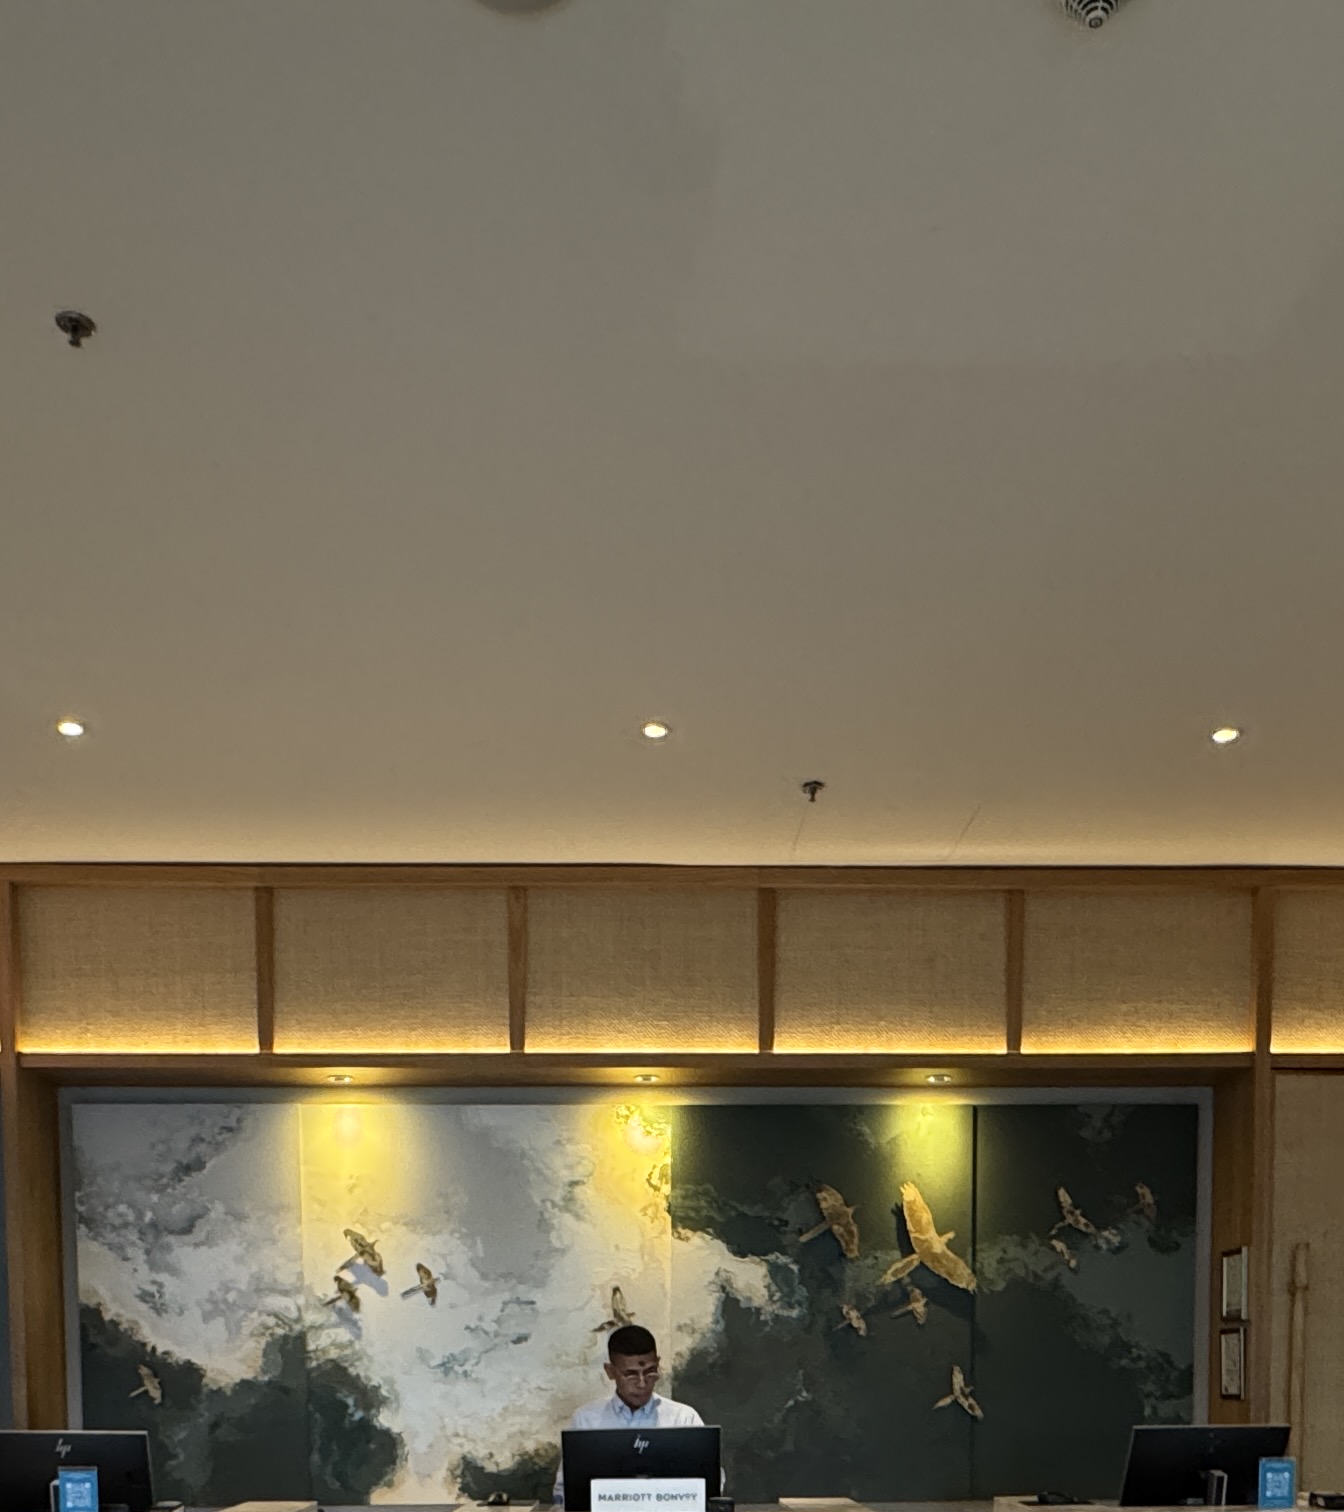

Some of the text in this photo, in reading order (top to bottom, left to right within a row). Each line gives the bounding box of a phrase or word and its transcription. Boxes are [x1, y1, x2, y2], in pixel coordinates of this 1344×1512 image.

[55, 1438, 71, 1458] hp
[634, 1434, 650, 1454] hp
[598, 1493, 698, 1502] MARRIOTT BONVOY
